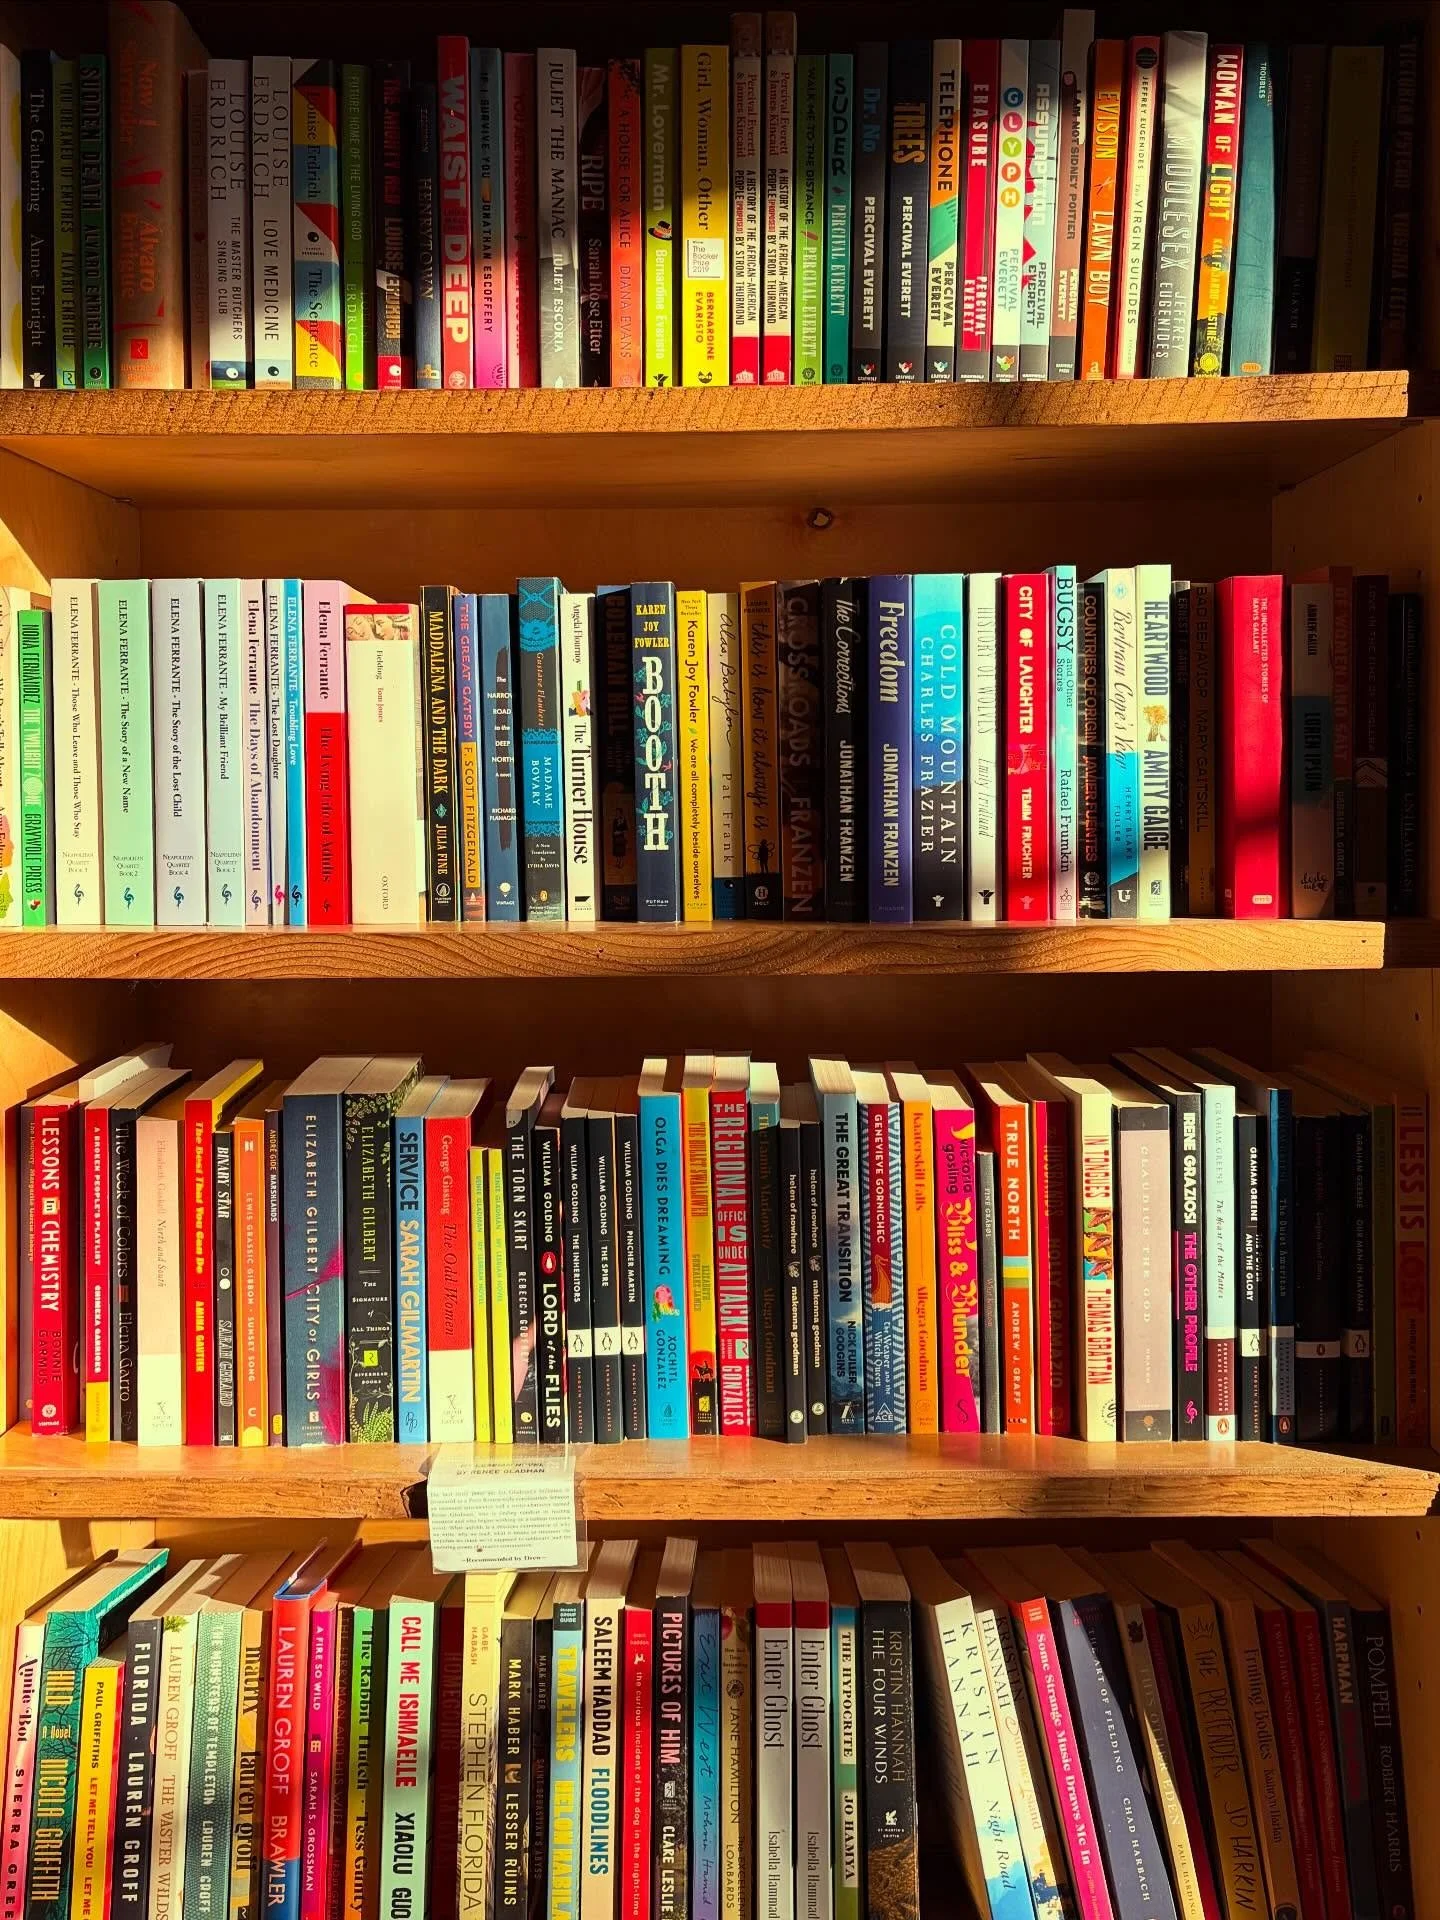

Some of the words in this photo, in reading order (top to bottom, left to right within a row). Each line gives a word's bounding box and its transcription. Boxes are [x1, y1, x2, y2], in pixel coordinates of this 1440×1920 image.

[29, 90, 44, 126] The
[549, 62, 563, 117] JULIET
[1214, 55, 1238, 124] WOMAN
[442, 76, 466, 208] WAIST
[551, 125, 563, 159] THE
[893, 103, 925, 164] TREES
[938, 70, 954, 191] TELEPHONE
[1096, 91, 1118, 159] EVISON
[1215, 135, 1231, 152] OF
[27, 129, 44, 212] Gathering
[582, 155, 604, 210] RIPE
[779, 176, 789, 209] HISTORY
[1209, 164, 1232, 220] LIGHT
[232, 217, 240, 236] THE
[551, 168, 564, 238] MANIAC
[779, 212, 789, 223] OF
[902, 197, 912, 258] PERCIVAL
[1161, 134, 1193, 270] MIDDLESEX
[30, 234, 44, 281] Anne
[263, 220, 278, 260] LOVE
[779, 226, 789, 241] THE
[1090, 210, 1112, 262] LAWN
[217, 241, 227, 282] SINGING
[231, 241, 241, 282] MASTER
[589, 239, 602, 280] Sarah
[218, 289, 228, 314] CLUB
[232, 287, 242, 340] BUTCHERS
[264, 266, 279, 340] MEDICINE
[445, 235, 468, 343] DEEP
[590, 283, 601, 316] Rose
[900, 263, 911, 317] EVERETT
[1088, 271, 1109, 305] BOY
[29, 284, 45, 346] Enright
[589, 319, 602, 354] Etter
[1156, 283, 1170, 358] EUGENIDES
[1172, 292, 1184, 350] JEFFREY
[1019, 586, 1032, 619] CITY
[429, 611, 444, 692] MADDALENA
[687, 620, 698, 657] Karen
[880, 600, 905, 703] Freedom
[941, 624, 956, 700] COLD
[1020, 629, 1032, 647] OF
[1144, 601, 1167, 696] HEARTWOOD
[686, 661, 698, 681] Joy
[921, 637, 933, 742] CHARLES
[1019, 656, 1033, 734] LAUGHTER
[172, 701, 180, 719] The
[432, 698, 446, 724] AND
[688, 685, 700, 723] Fowler
[171, 721, 181, 742] Story
[173, 745, 181, 753] of
[433, 728, 446, 755] THE
[574, 723, 587, 743] The
[690, 739, 699, 753] We
[173, 773, 181, 791] Lost
[434, 759, 447, 794] DARK
[531, 760, 541, 806] BOVARY
[543, 757, 553, 809] MADAME
[572, 745, 590, 805] Turner
[690, 755, 698, 769] are
[691, 772, 700, 781] all
[883, 744, 899, 817] JONATHAN
[1144, 750, 1168, 799] AMITY
[173, 794, 182, 817] Child
[689, 784, 700, 829] completely
[921, 755, 934, 852] FRAZIER
[940, 716, 957, 864] MOUNTAIN
[1022, 788, 1032, 820] TEMIM
[1060, 769, 1072, 810] Rafael
[573, 810, 592, 864] House
[692, 832, 701, 858] beside
[1022, 827, 1032, 878] FRUCHTER
[1060, 815, 1072, 872] Frumkin
[1144, 806, 1169, 851] GAIGE
[693, 861, 701, 899] ourselves
[883, 823, 899, 886] FRANZEN
[655, 1118, 668, 1156] OLGA
[835, 1113, 849, 1142] THE
[875, 1114, 884, 1175] GENEVIEVE
[1006, 1120, 1019, 1169] TRUE
[1184, 1113, 1196, 1150] IRENE
[42, 1118, 60, 1190] LESSONS
[306, 1115, 317, 1197] ELIZABETH
[399, 1132, 418, 1210] SERVICE
[541, 1141, 552, 1186] WILLIAM
[656, 1162, 668, 1192] DIES
[836, 1146, 850, 1199] GREAT
[45, 1200, 56, 1212] In
[789, 1174, 797, 1200] helen
[790, 1202, 797, 1213] of
[876, 1179, 886, 1243] GORNICHEC
[1008, 1178, 1021, 1240] NORTH
[1184, 1156, 1197, 1223] GRAZIOSI
[306, 1207, 317, 1273] GILBERT
[543, 1192, 553, 1242] GOLDING
[657, 1198, 670, 1275] DREAMING
[789, 1214, 798, 1254] nowhere
[41, 1221, 60, 1311] CHEMISTRY
[401, 1221, 419, 1286] SARAH
[837, 1202, 851, 1302] TRANSITION
[543, 1284, 558, 1335] LORD
[1087, 1289, 1110, 1333] THOMAS
[402, 1291, 420, 1402] GILMARTIN
[548, 1341, 554, 1351] of
[656, 1330, 667, 1389] GONZALEZ
[667, 1335, 677, 1383] XOCHITL
[791, 1331, 800, 1375] goodman
[1087, 1337, 1112, 1384] GRATTAN
[545, 1374, 561, 1427] FLIES
[401, 1616, 421, 1652] CALL
[593, 1616, 612, 1679] SALEEM
[842, 1632, 852, 1662] THE
[872, 1629, 885, 1660] THE
[131, 1643, 150, 1726] FLORIDA
[400, 1662, 420, 1684] ME
[890, 1631, 904, 1695] KRISTIN
[1366, 1636, 1391, 1727] POMPEII
[95, 1682, 104, 1708] PAUL
[635, 1690, 643, 1727] curious
[843, 1669, 853, 1757] HYPOCRITE
[874, 1669, 886, 1716] FOUR
[92, 1712, 102, 1768] GRIFFITHS
[396, 1694, 419, 1787] ISHMAELLE
[592, 1686, 612, 1755] HADDAD
[891, 1704, 904, 1782] HANNAH
[466, 1694, 487, 1800] STEPHEN
[875, 1724, 887, 1784] WINDS
[126, 1752, 145, 1827] LAUREN
[634, 1775, 641, 1785] of
[845, 1796, 854, 1815] JO
[505, 1793, 519, 1850] LESSER
[590, 1768, 610, 1874] FLOODLINES
[632, 1807, 641, 1825] dog
[633, 1829, 640, 1839] in
[394, 1812, 415, 1874] XIAOLU
[463, 1810, 484, 1911] FLORIDA
[845, 1819, 856, 1880] HAMYA
[123, 1840, 140, 1902] GROFF
[504, 1859, 518, 1905] RUINS
[631, 1863, 640, 1915] night-time
